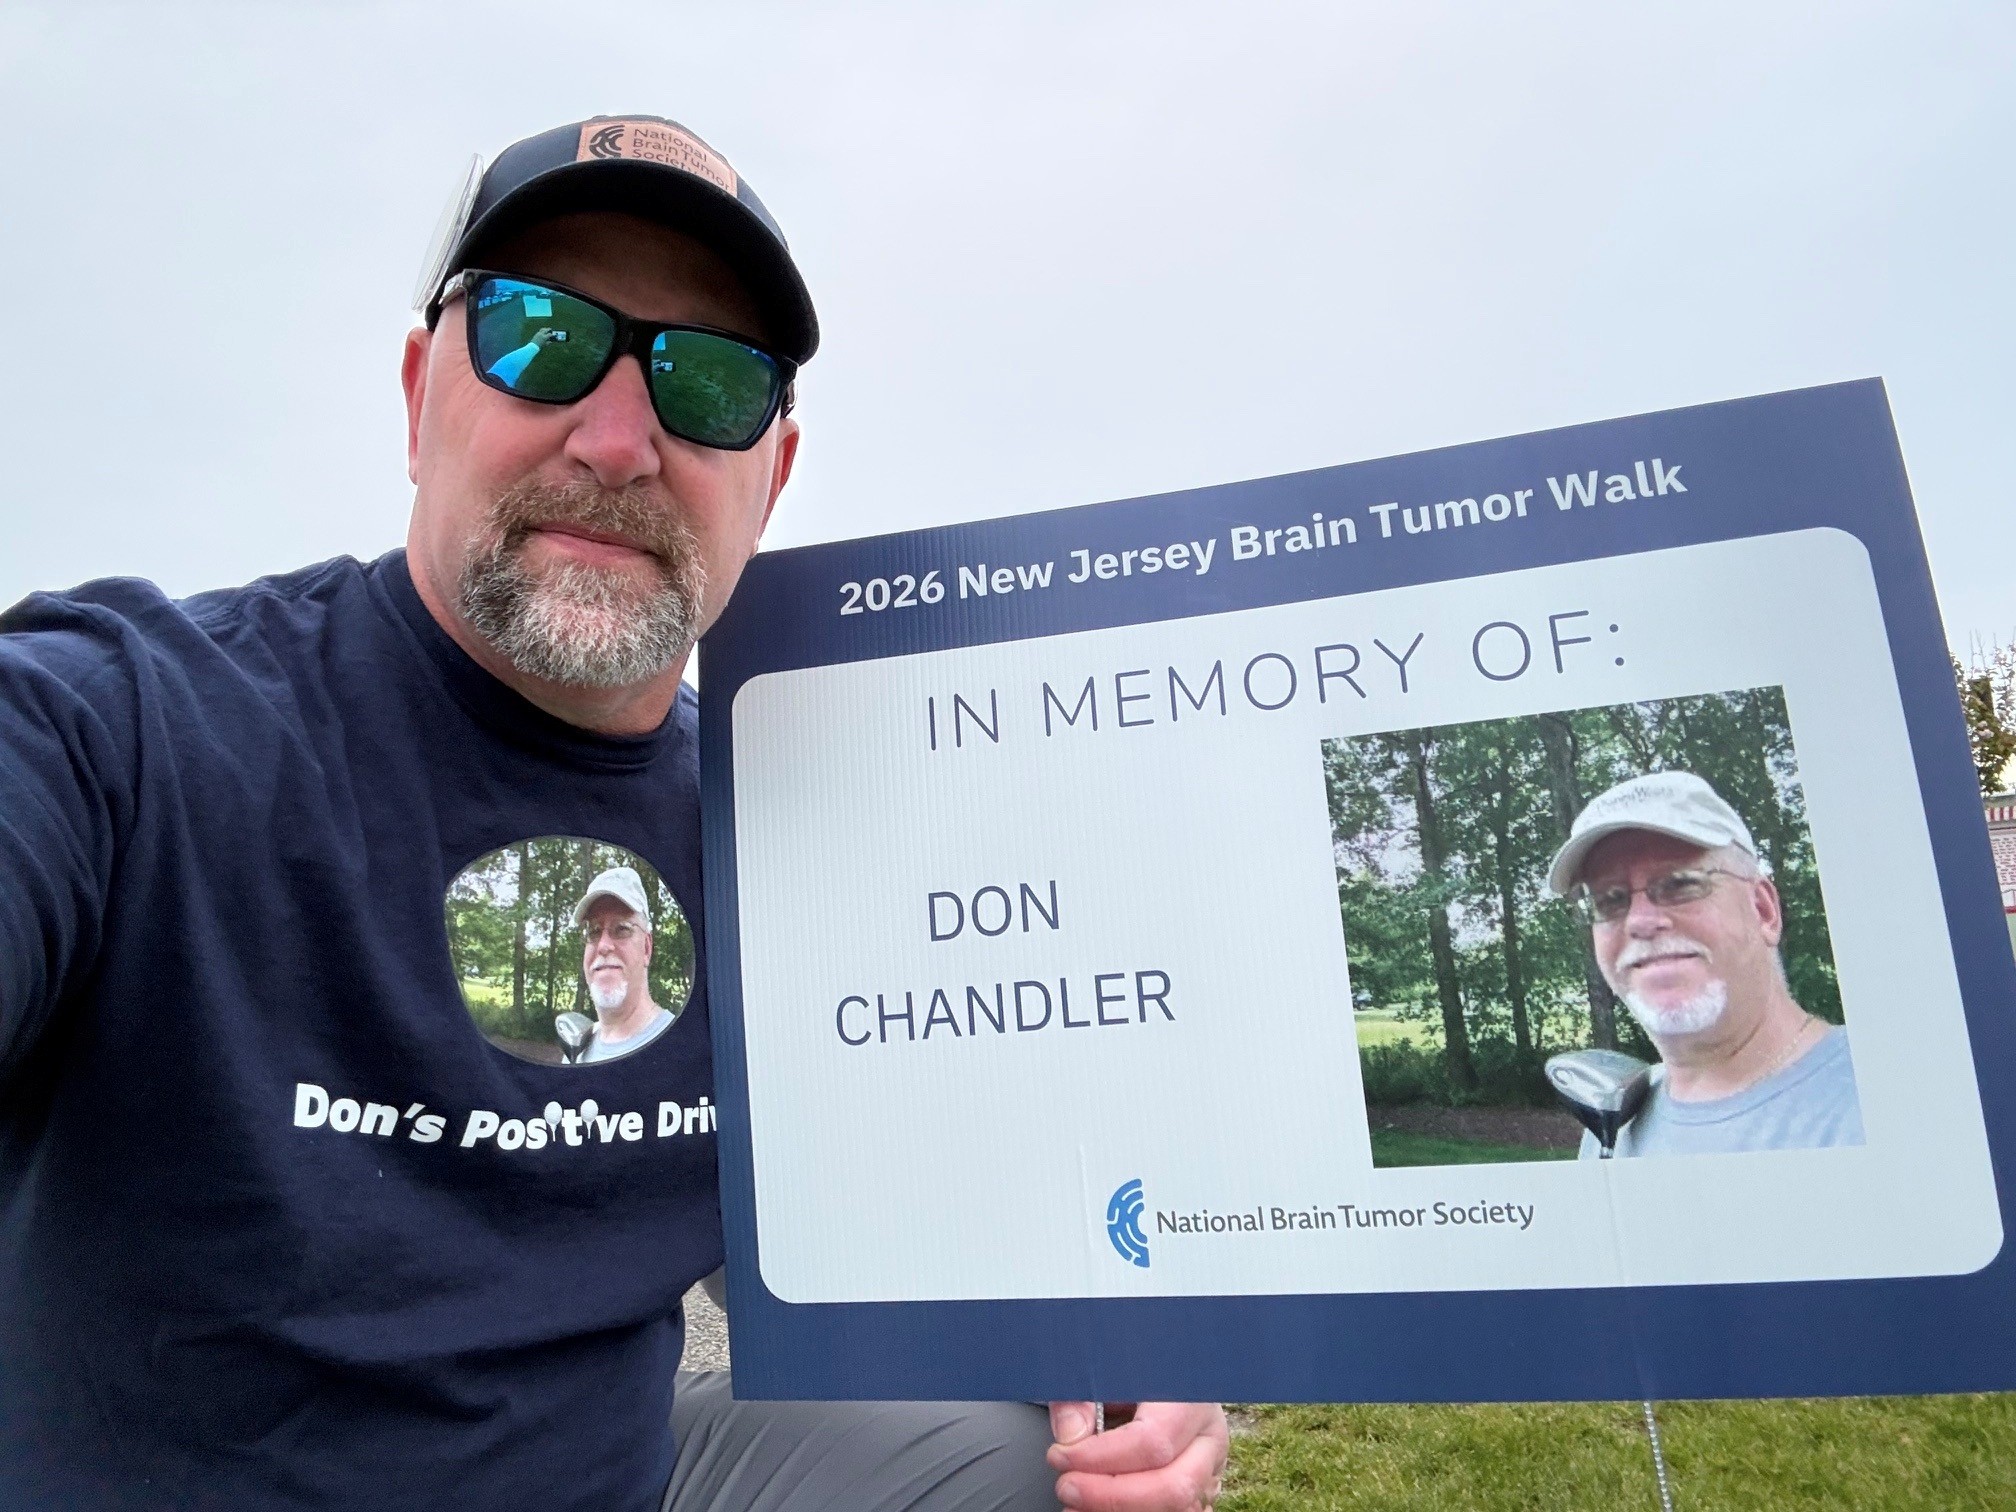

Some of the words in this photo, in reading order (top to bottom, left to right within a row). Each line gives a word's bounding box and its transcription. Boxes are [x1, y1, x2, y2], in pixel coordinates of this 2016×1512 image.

[631, 149, 697, 174] Societ
[632, 138, 678, 155] Brain
[681, 149, 730, 190] Tumor
[634, 128, 707, 162] National
[839, 571, 945, 616] 2026
[958, 562, 1054, 599] New
[1067, 539, 1217, 584] Jersey
[1230, 513, 1358, 561] Brain
[1368, 489, 1534, 538] Tumor
[1546, 459, 1688, 511] Walk
[927, 689, 999, 751] IN
[1042, 632, 1424, 737] MEMORY
[1472, 611, 1625, 681] OF:
[928, 880, 1060, 942] DON
[836, 970, 1176, 1046] CHANDLER
[1156, 1206, 1264, 1234] National
[1270, 1207, 1337, 1231] Brain
[1338, 1204, 1427, 1229] Tumor
[1432, 1201, 1534, 1231] Society
